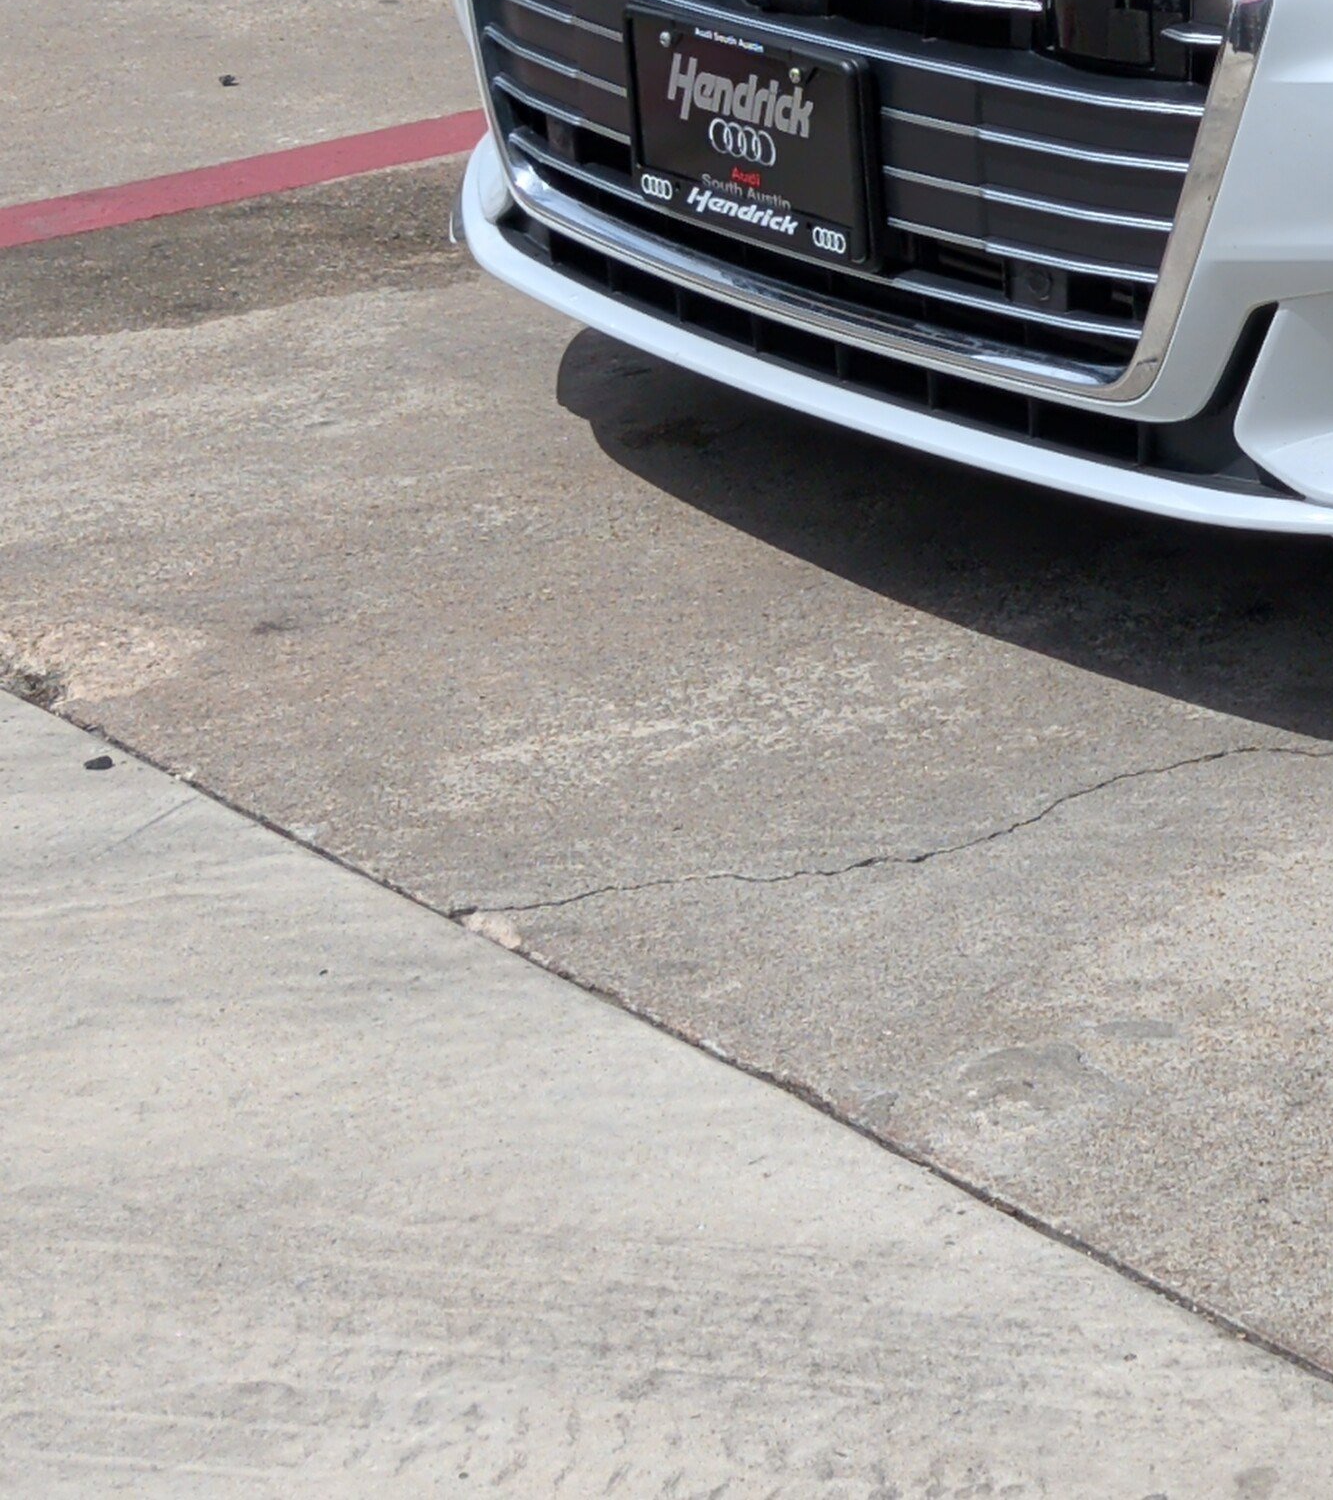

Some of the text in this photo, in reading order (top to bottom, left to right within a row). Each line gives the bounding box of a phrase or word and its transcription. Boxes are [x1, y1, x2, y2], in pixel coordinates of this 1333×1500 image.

[694, 27, 713, 39] Audi
[667, 52, 814, 139] Hendrick
[701, 173, 792, 211] South Austin
[731, 166, 761, 187] Audi
[686, 186, 799, 236] Hendrick
